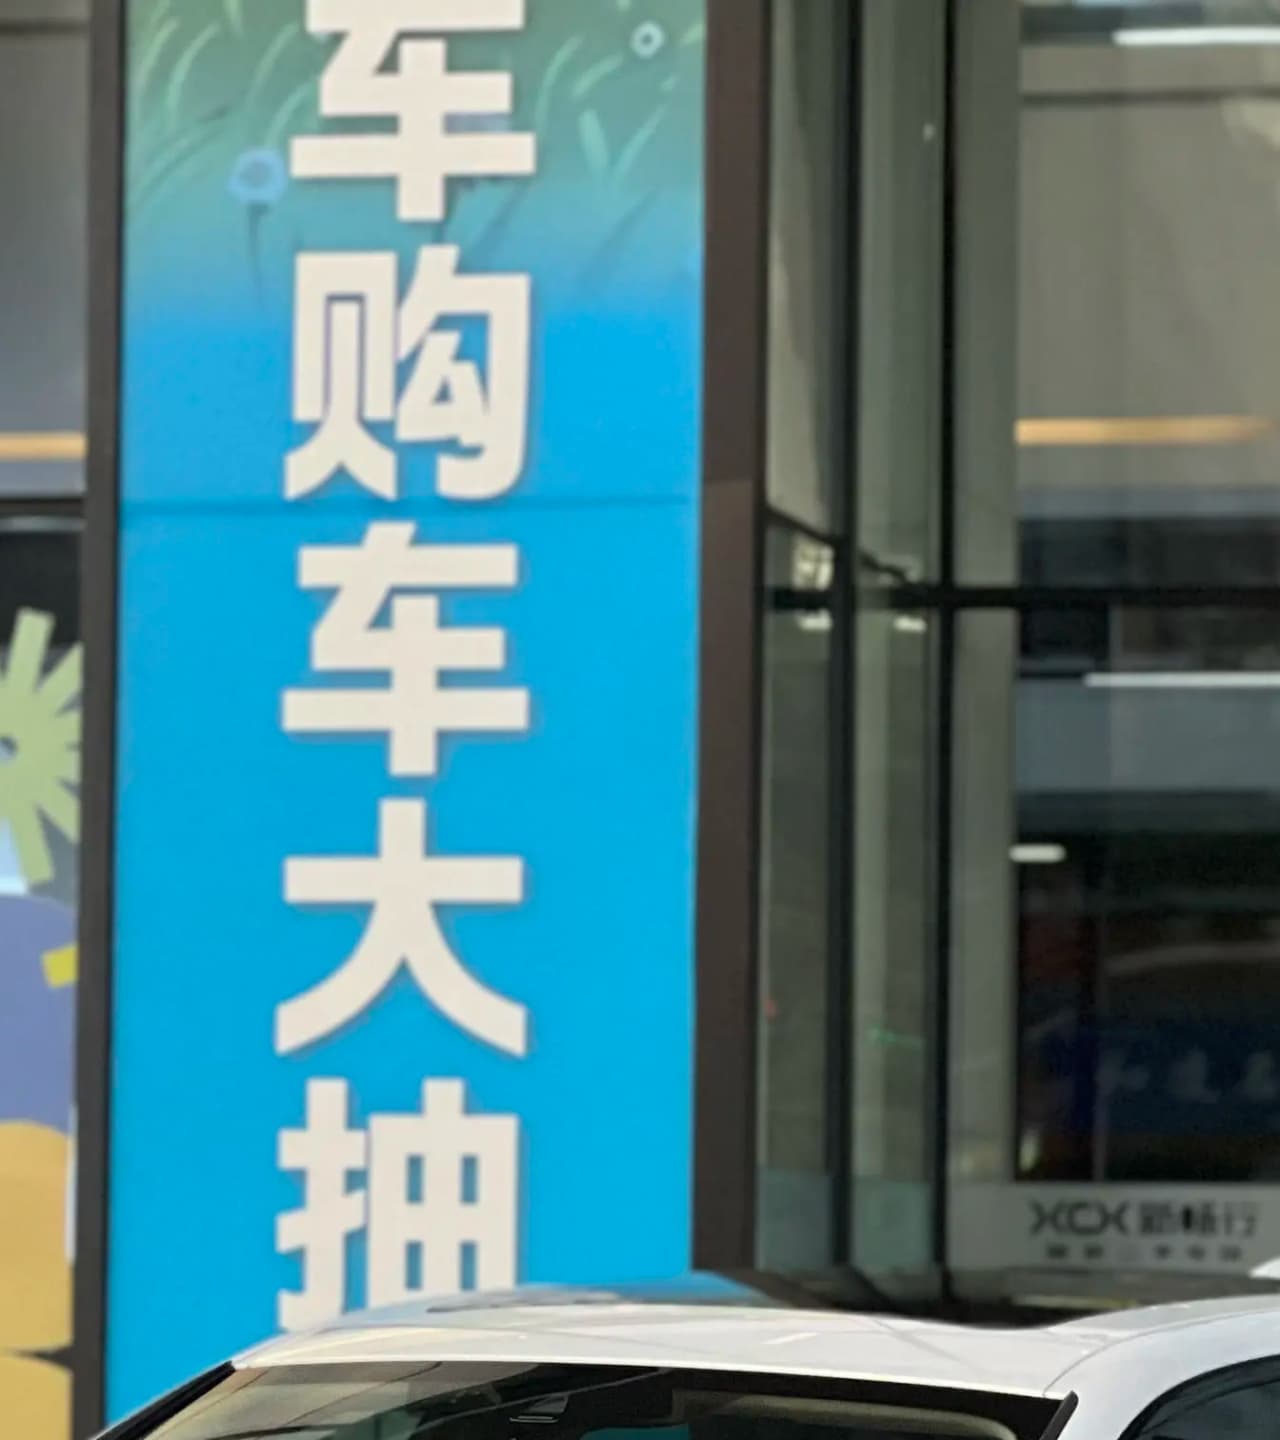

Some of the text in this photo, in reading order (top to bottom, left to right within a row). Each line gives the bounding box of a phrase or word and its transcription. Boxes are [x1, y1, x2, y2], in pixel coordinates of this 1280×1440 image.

[275, 0, 535, 1333] 车购车大抽
